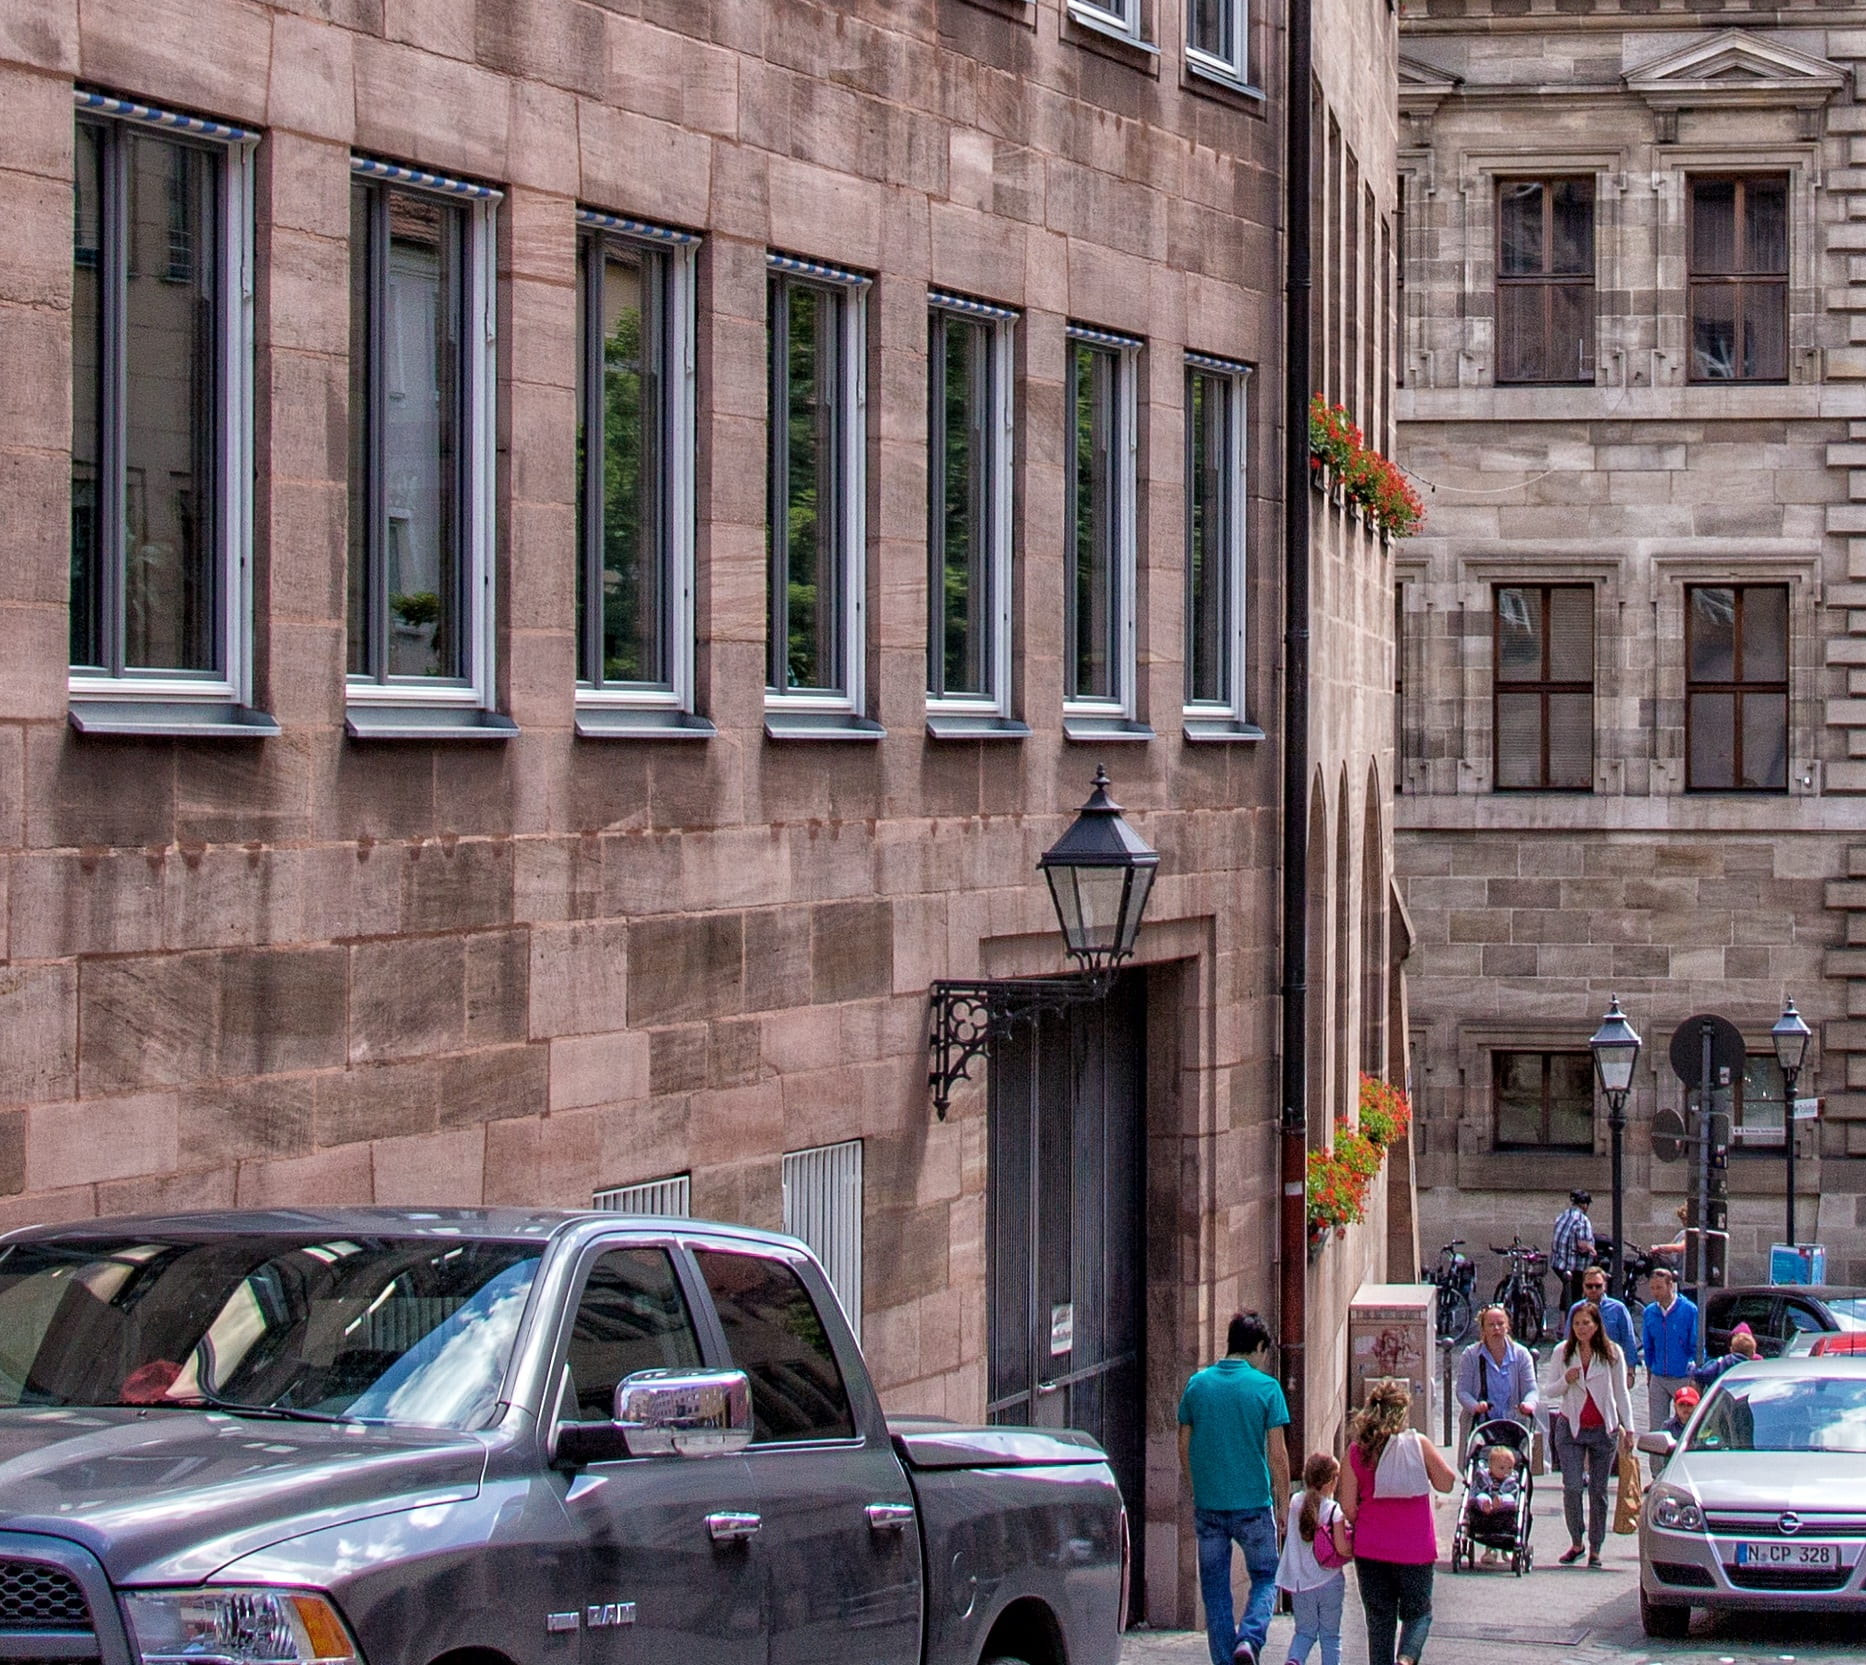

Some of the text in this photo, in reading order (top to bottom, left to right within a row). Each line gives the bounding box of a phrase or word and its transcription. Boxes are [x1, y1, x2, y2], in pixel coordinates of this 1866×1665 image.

[1748, 1545, 1830, 1563] N CP 328
[587, 1602, 637, 1627] RAM
